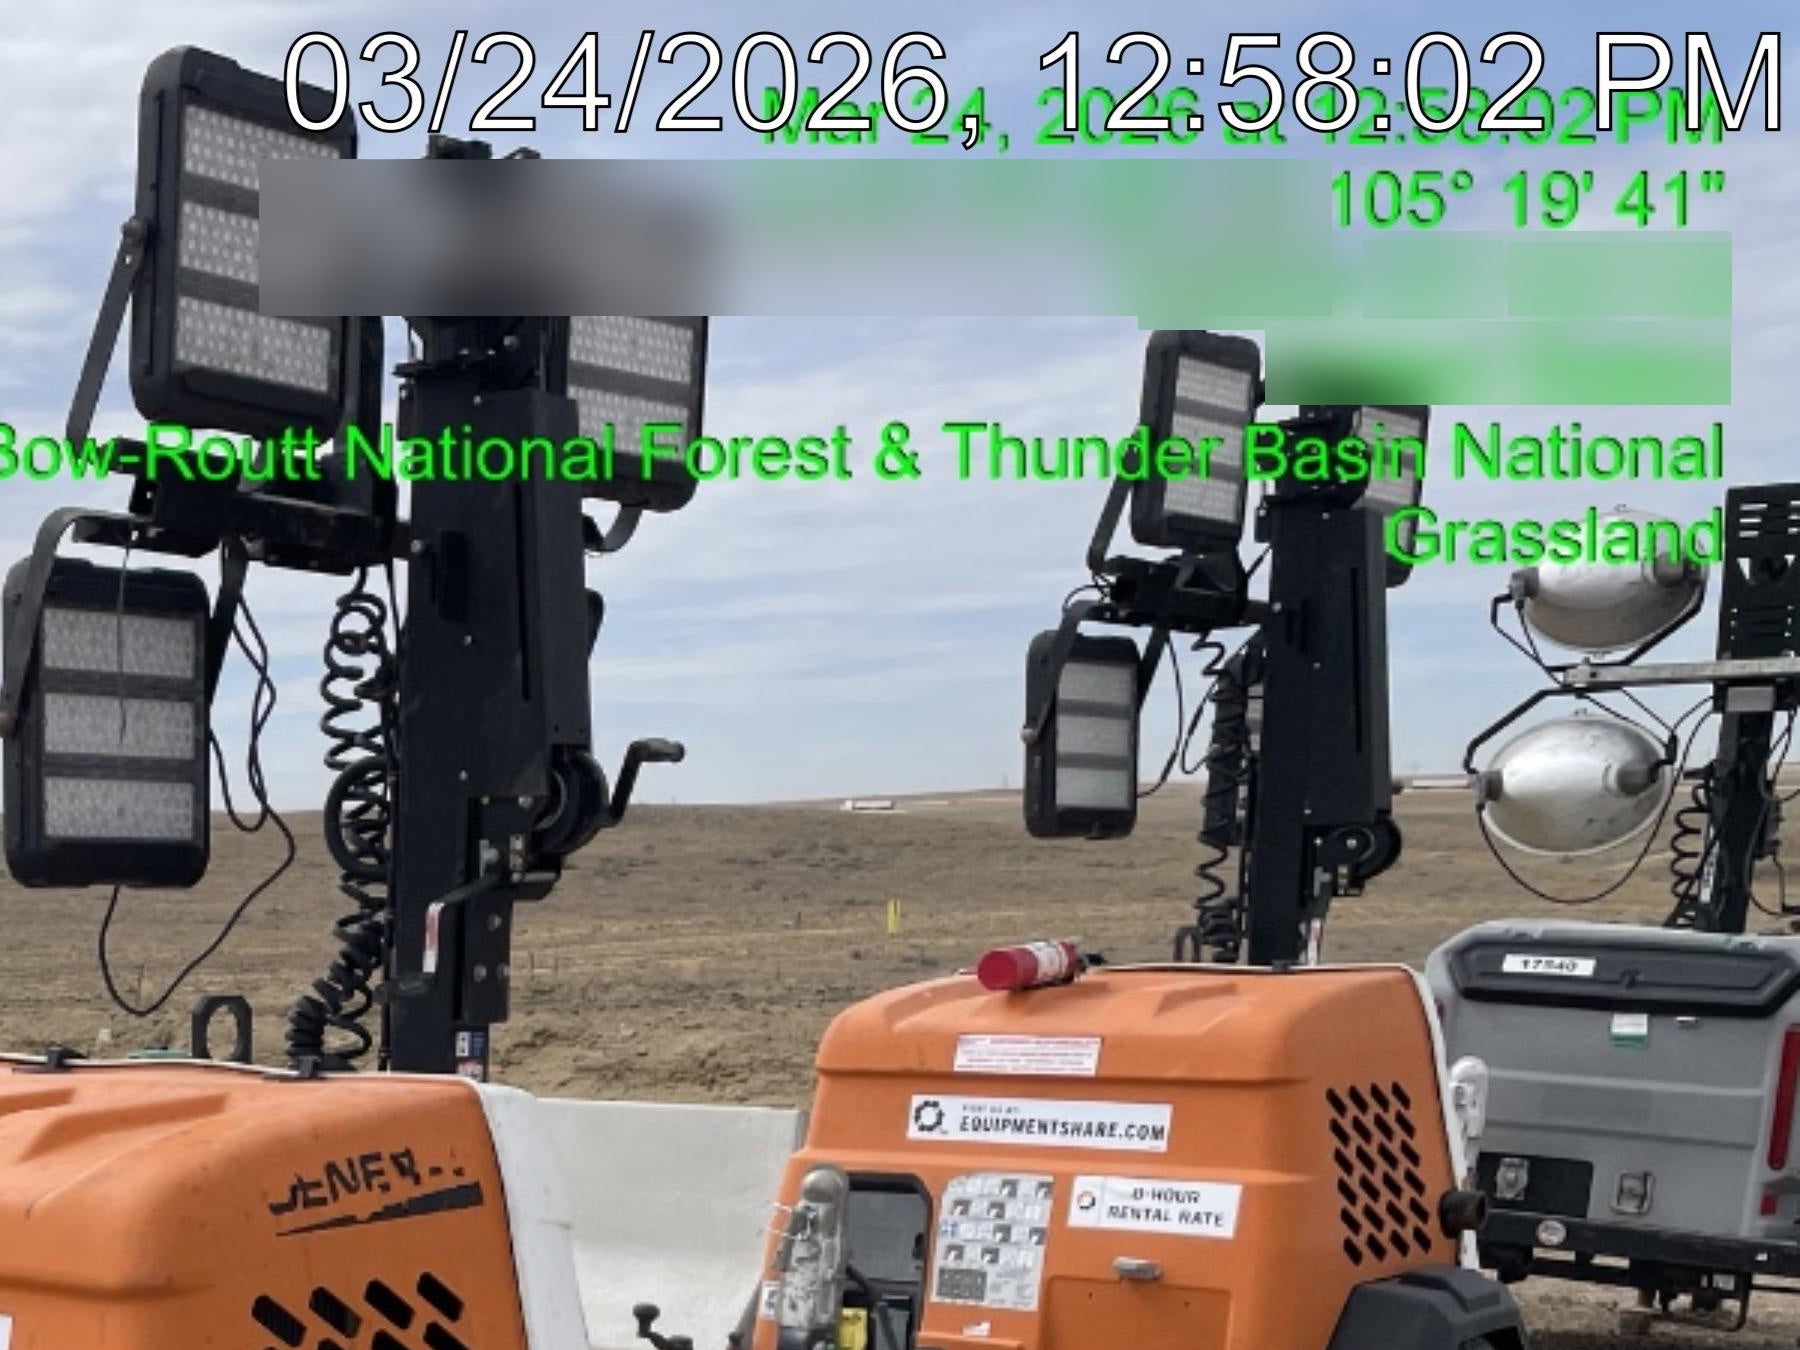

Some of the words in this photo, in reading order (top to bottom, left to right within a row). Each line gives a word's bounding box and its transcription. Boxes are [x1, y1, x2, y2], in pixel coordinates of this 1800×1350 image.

[960, 1115, 1165, 1141] EQUIPMENTSHARE.COM
[1107, 1205, 1172, 1222] RENTAL
[1178, 1210, 1225, 1228] RATE
